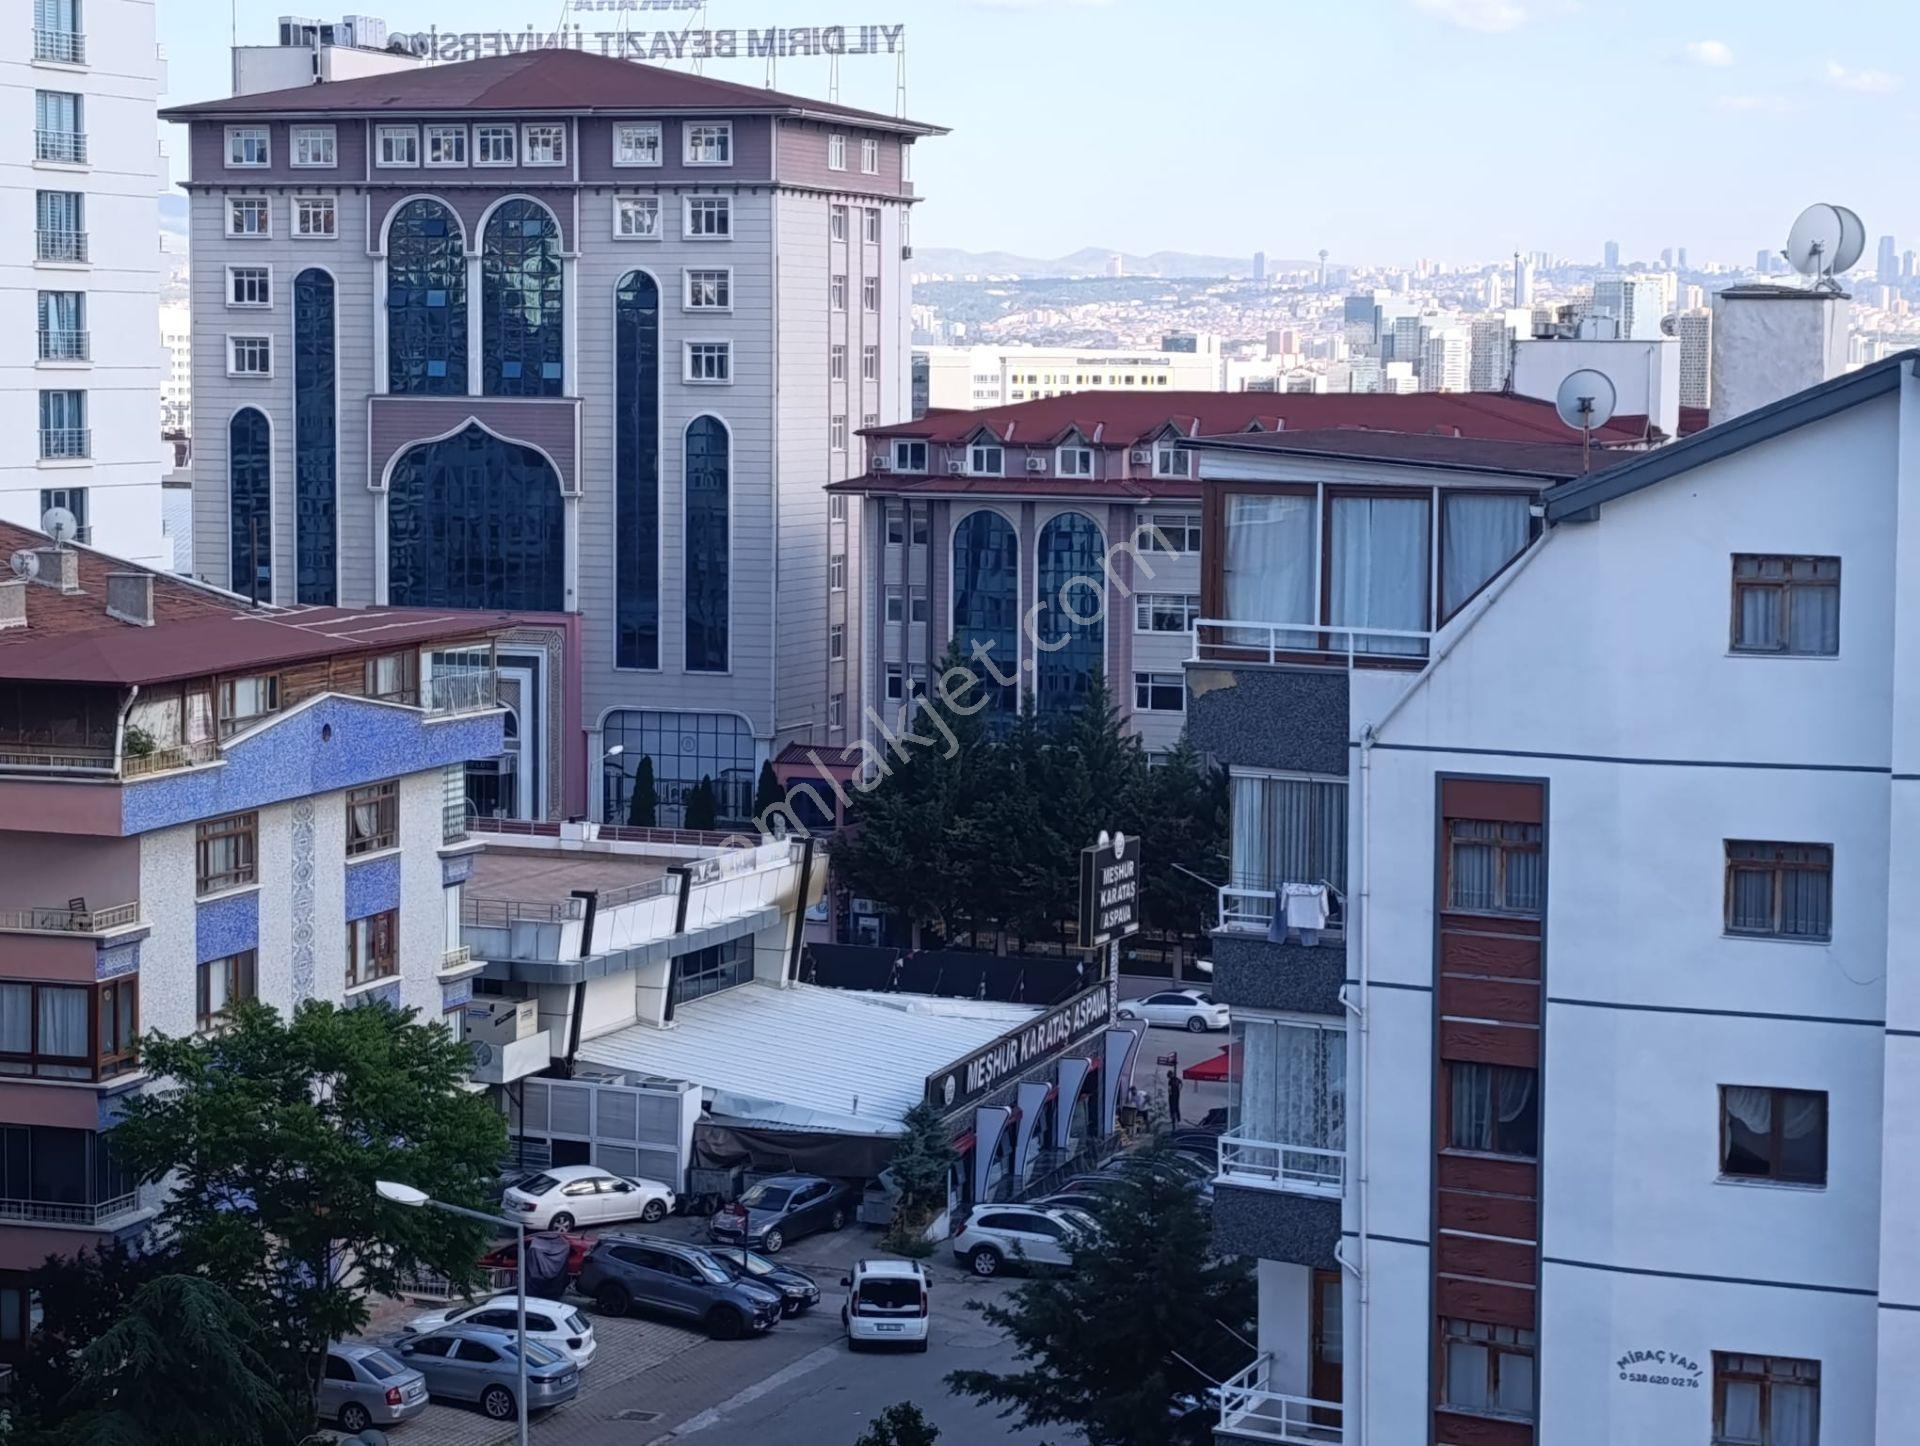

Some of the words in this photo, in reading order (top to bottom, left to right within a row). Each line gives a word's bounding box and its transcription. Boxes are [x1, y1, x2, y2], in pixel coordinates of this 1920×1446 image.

[1103, 905, 1131, 930] ASPAVA
[966, 1038, 1018, 1093] MEŞHUR
[1020, 1009, 1071, 1063] KARATAŞ
[1073, 986, 1108, 1033] ASPAVA
[1616, 1350, 1666, 1370] MİRAÇ
[1669, 1352, 1703, 1377] YAPI
